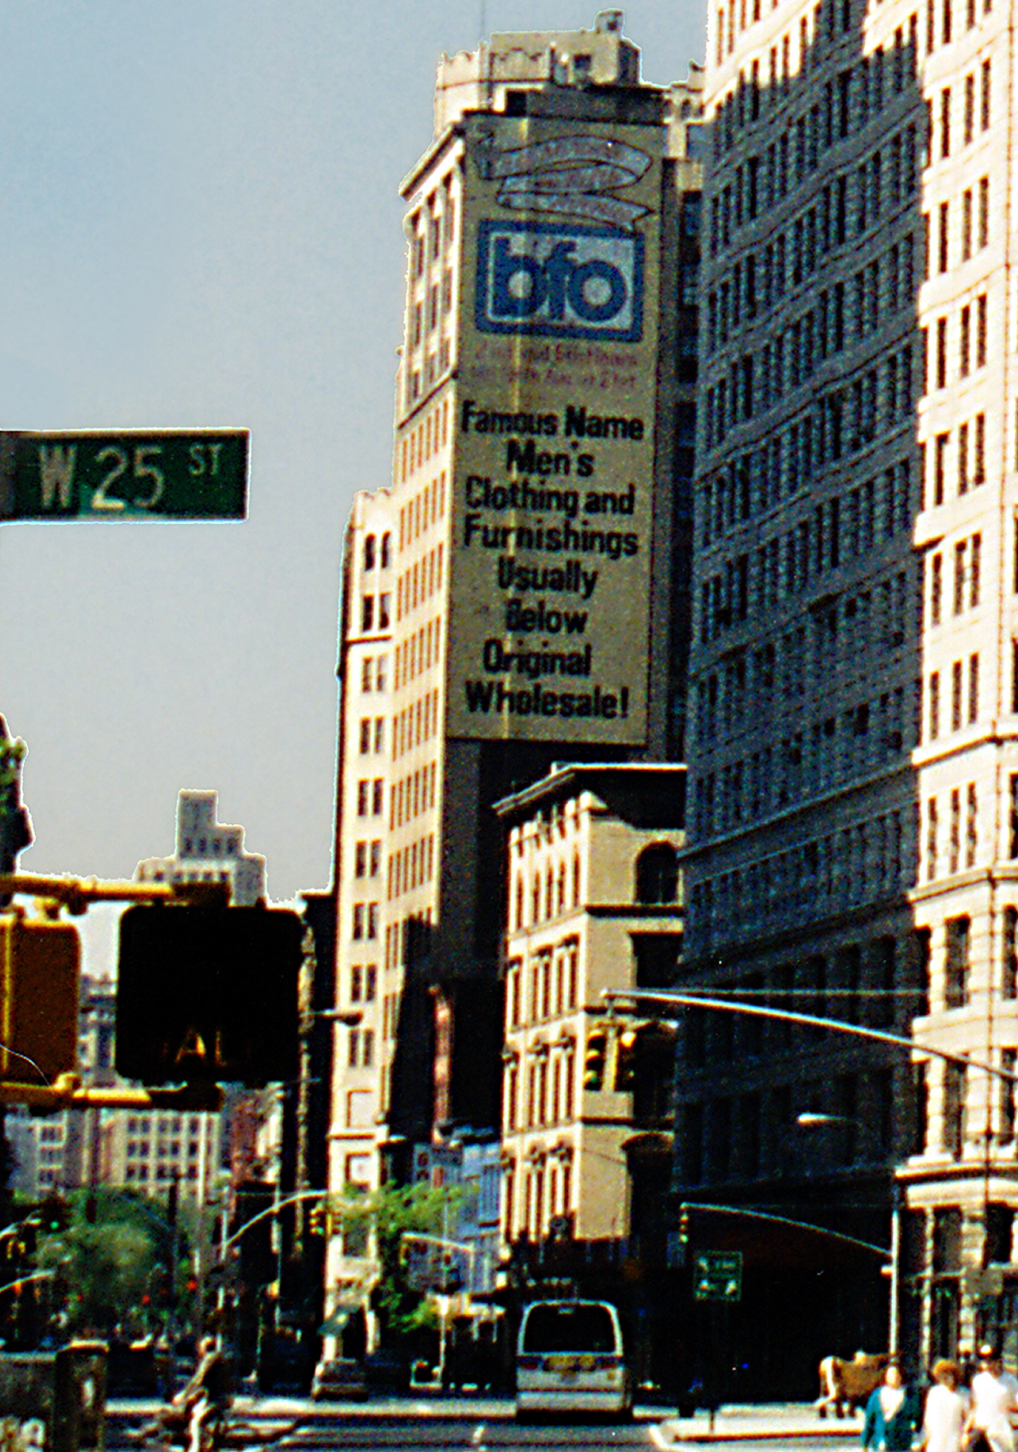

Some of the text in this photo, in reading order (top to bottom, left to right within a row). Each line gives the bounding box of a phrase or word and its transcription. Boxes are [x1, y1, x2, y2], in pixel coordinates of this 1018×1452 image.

[492, 236, 628, 322] bfo
[461, 400, 644, 441] Famous Name
[39, 444, 223, 510] W 25 ST
[506, 439, 595, 477] Men's
[465, 475, 635, 518] Clothing and
[464, 513, 639, 560] Furnishings
[498, 555, 598, 599] Usually
[505, 598, 588, 634] Below
[483, 638, 592, 679] Original
[465, 680, 629, 719] Wholesale!
